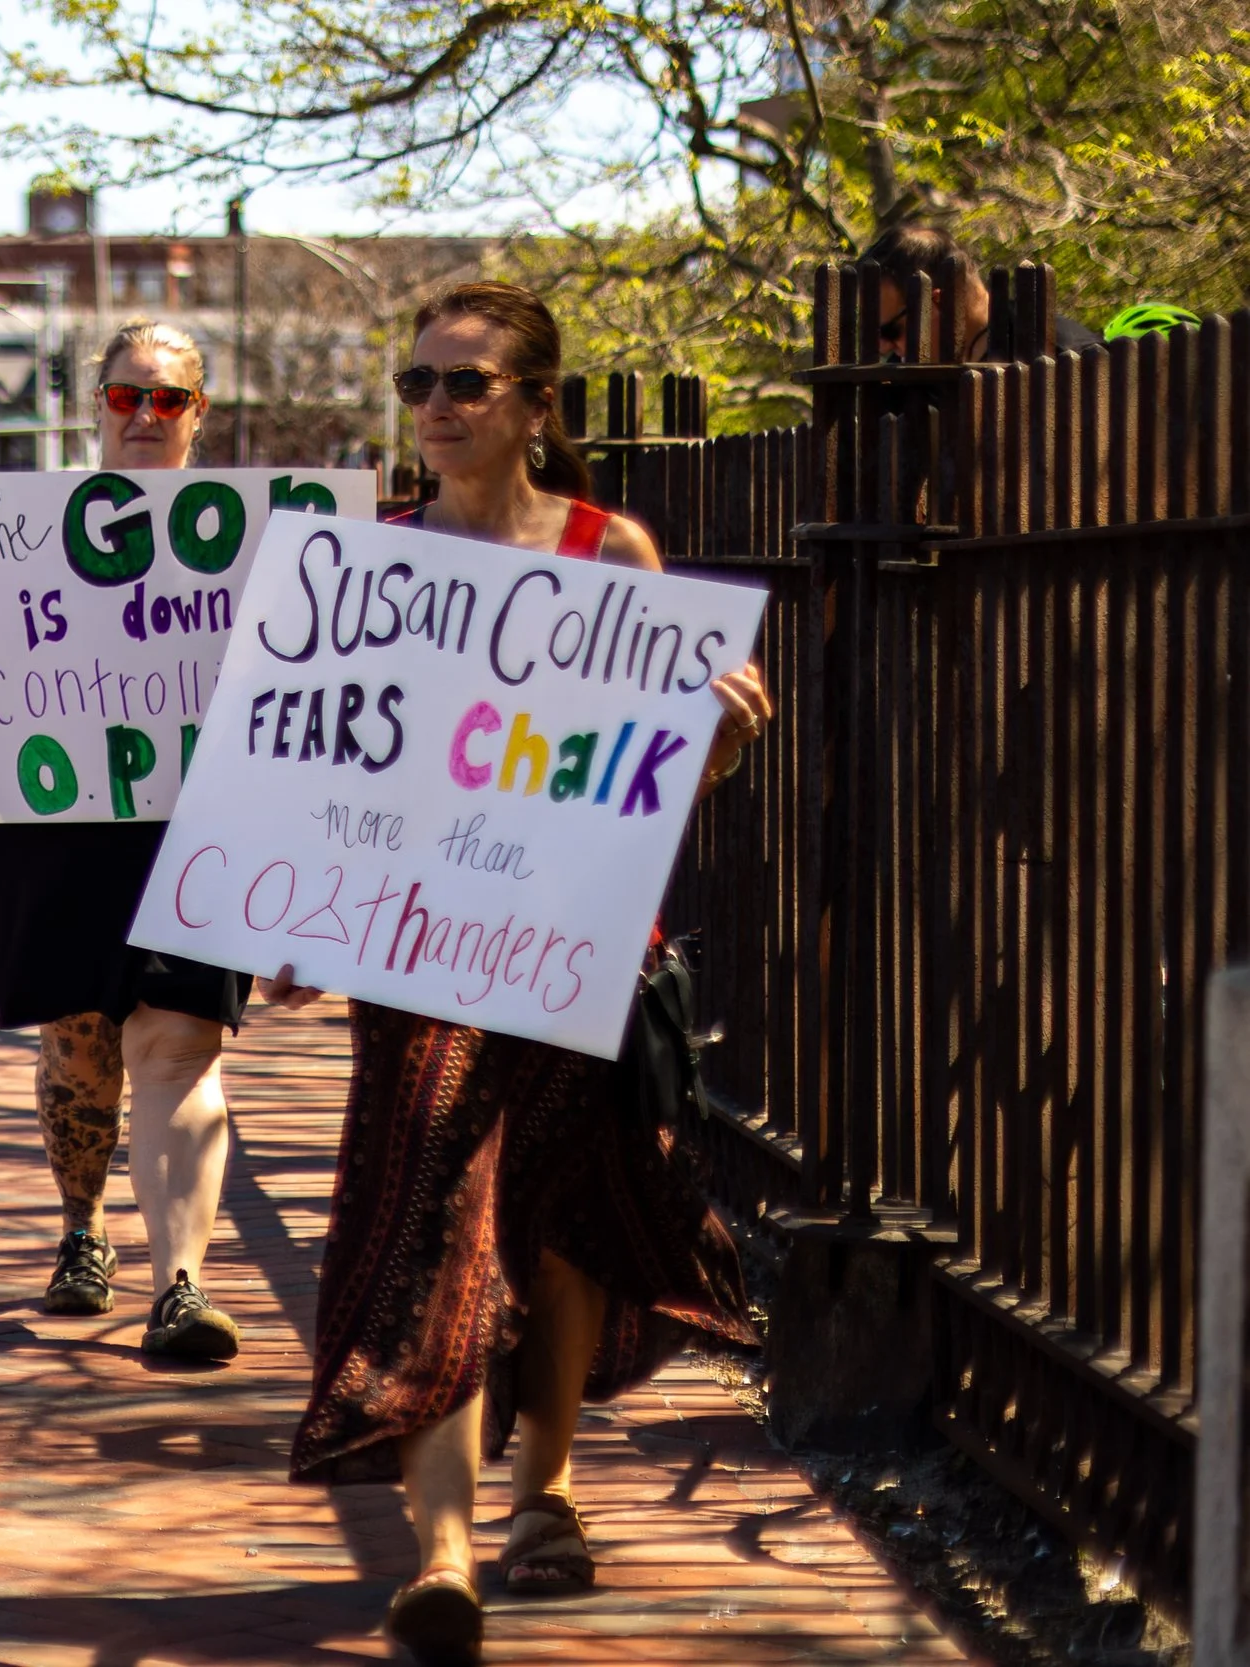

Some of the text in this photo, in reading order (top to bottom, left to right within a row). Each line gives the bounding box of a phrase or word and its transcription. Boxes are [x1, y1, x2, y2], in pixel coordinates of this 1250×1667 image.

[18, 582, 233, 651] is down
[258, 530, 726, 695] Susan Collins
[249, 683, 405, 774] FEARS
[311, 799, 535, 880] more than
